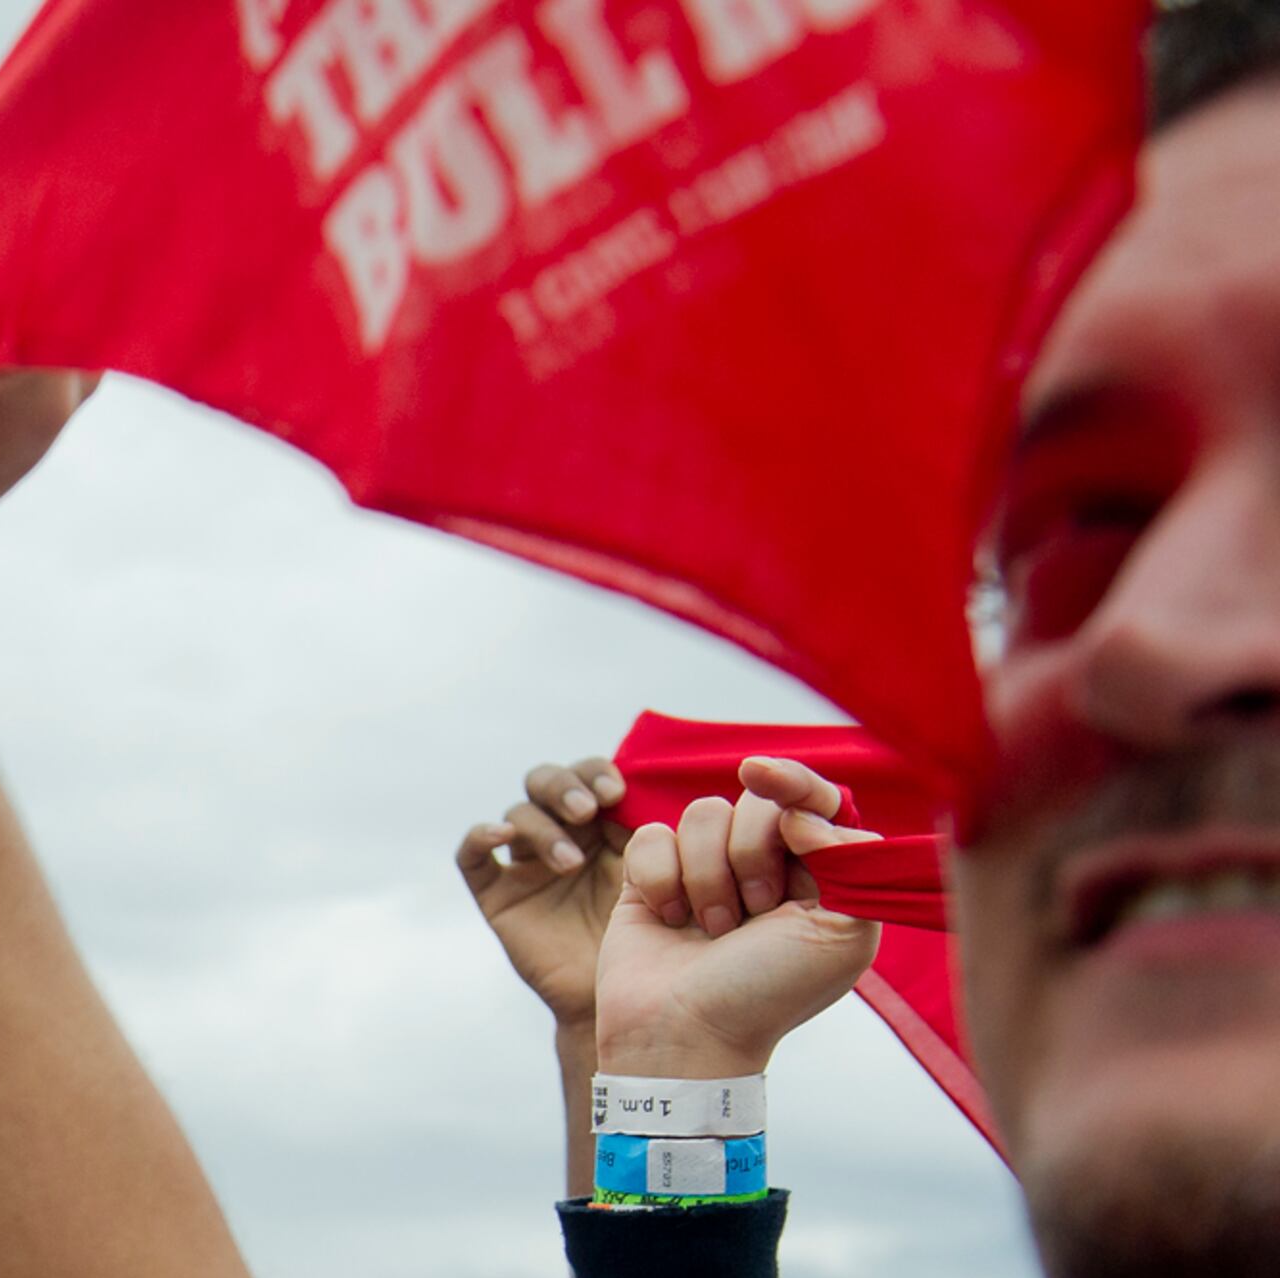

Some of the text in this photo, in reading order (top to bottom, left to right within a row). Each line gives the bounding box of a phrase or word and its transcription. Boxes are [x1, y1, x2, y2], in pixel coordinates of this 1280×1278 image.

[322, 0, 690, 354] BULL
[618, 1096, 655, 1113] p.m.
[659, 1099, 672, 1117] 1
